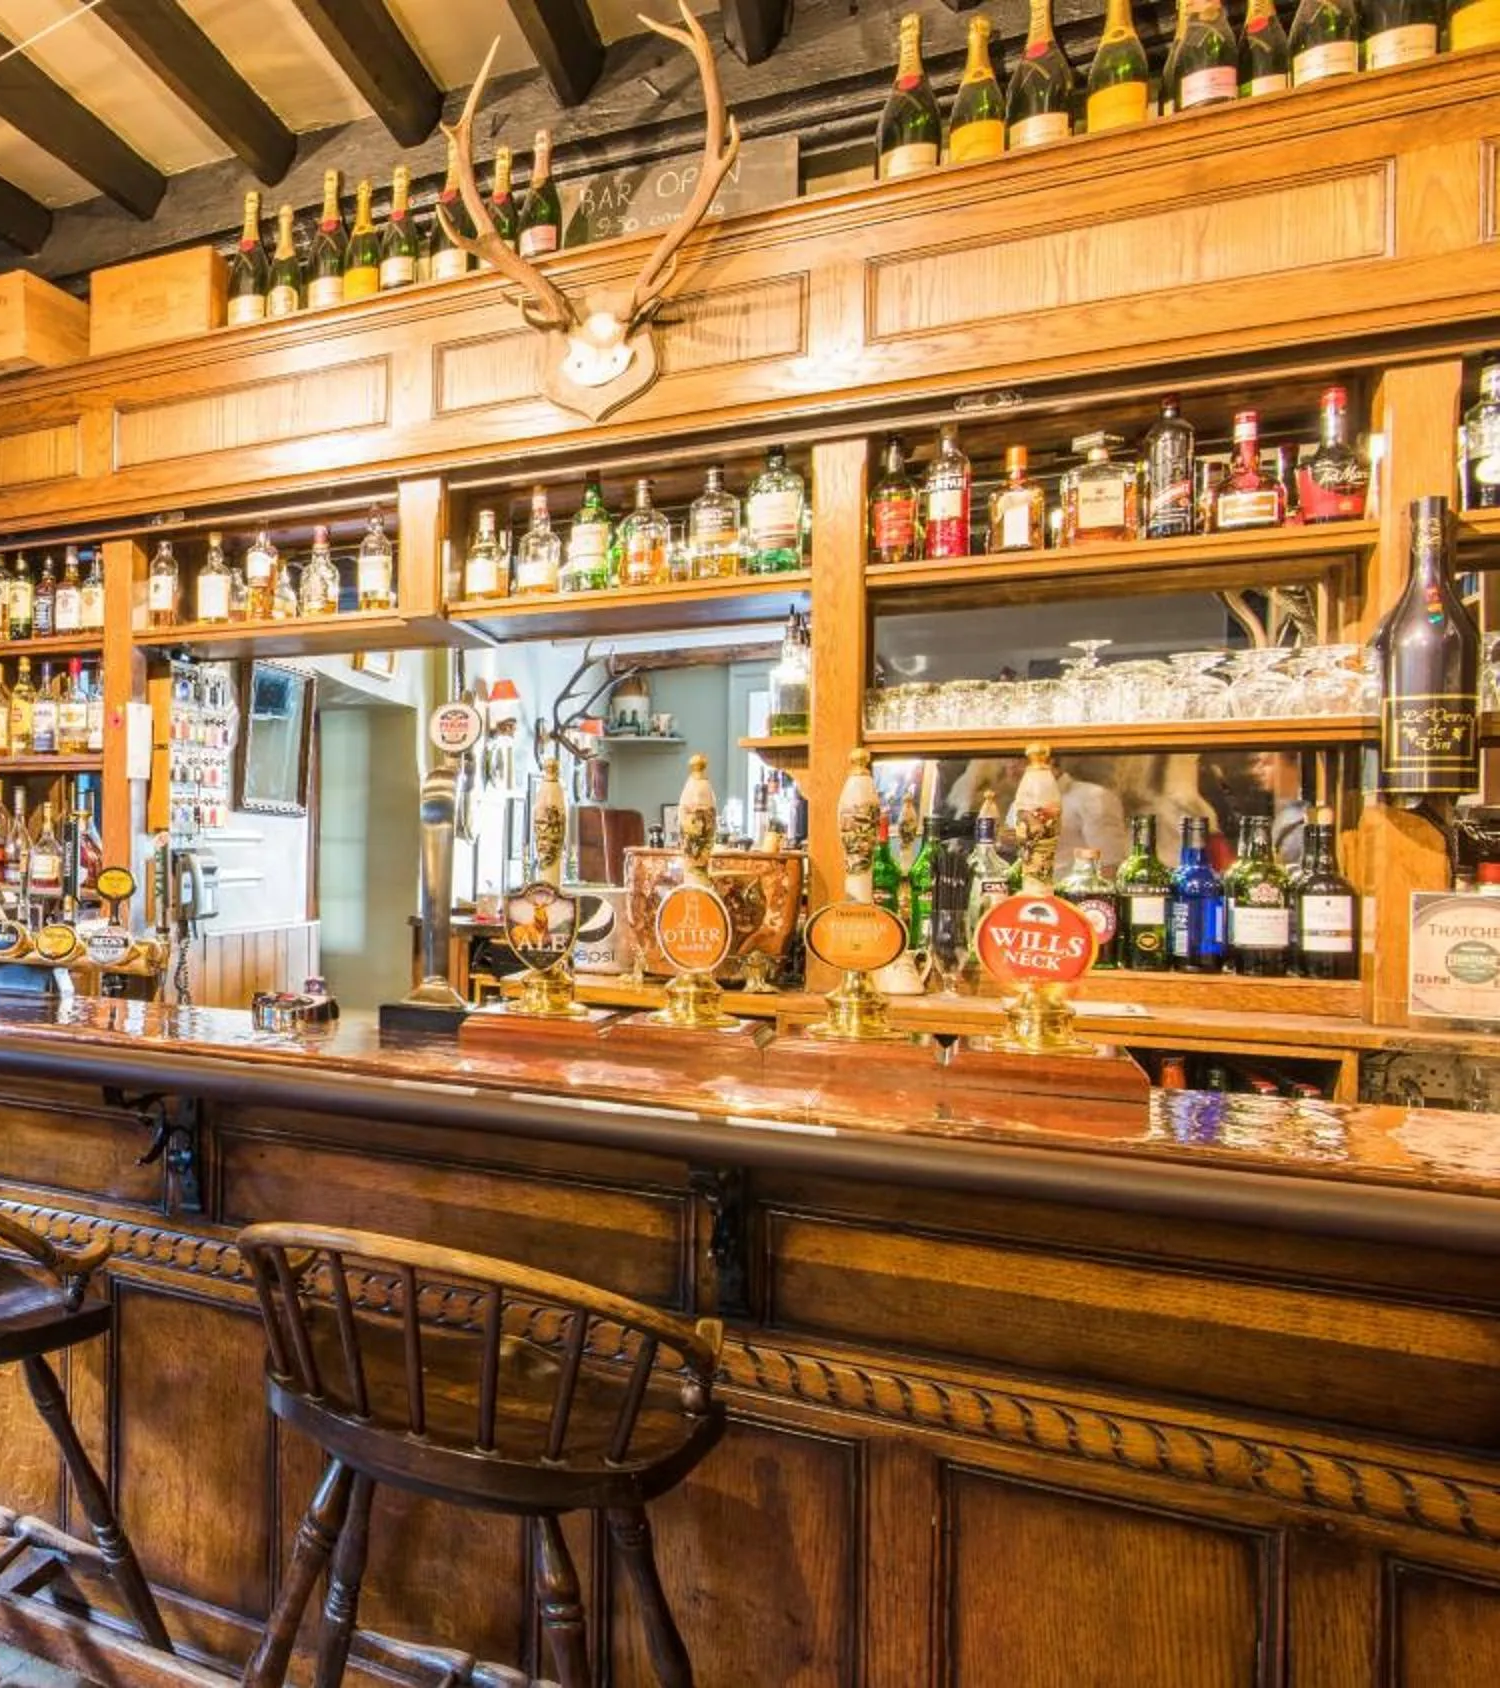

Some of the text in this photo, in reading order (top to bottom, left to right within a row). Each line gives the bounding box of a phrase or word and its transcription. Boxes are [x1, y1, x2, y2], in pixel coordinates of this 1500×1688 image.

[579, 159, 741, 216] BAR OPN
[516, 932, 571, 953] ALE
[663, 928, 721, 943] OTTER
[989, 927, 1086, 958] WILLS
[574, 947, 615, 965] epsi
[1004, 950, 1062, 971] NECK
